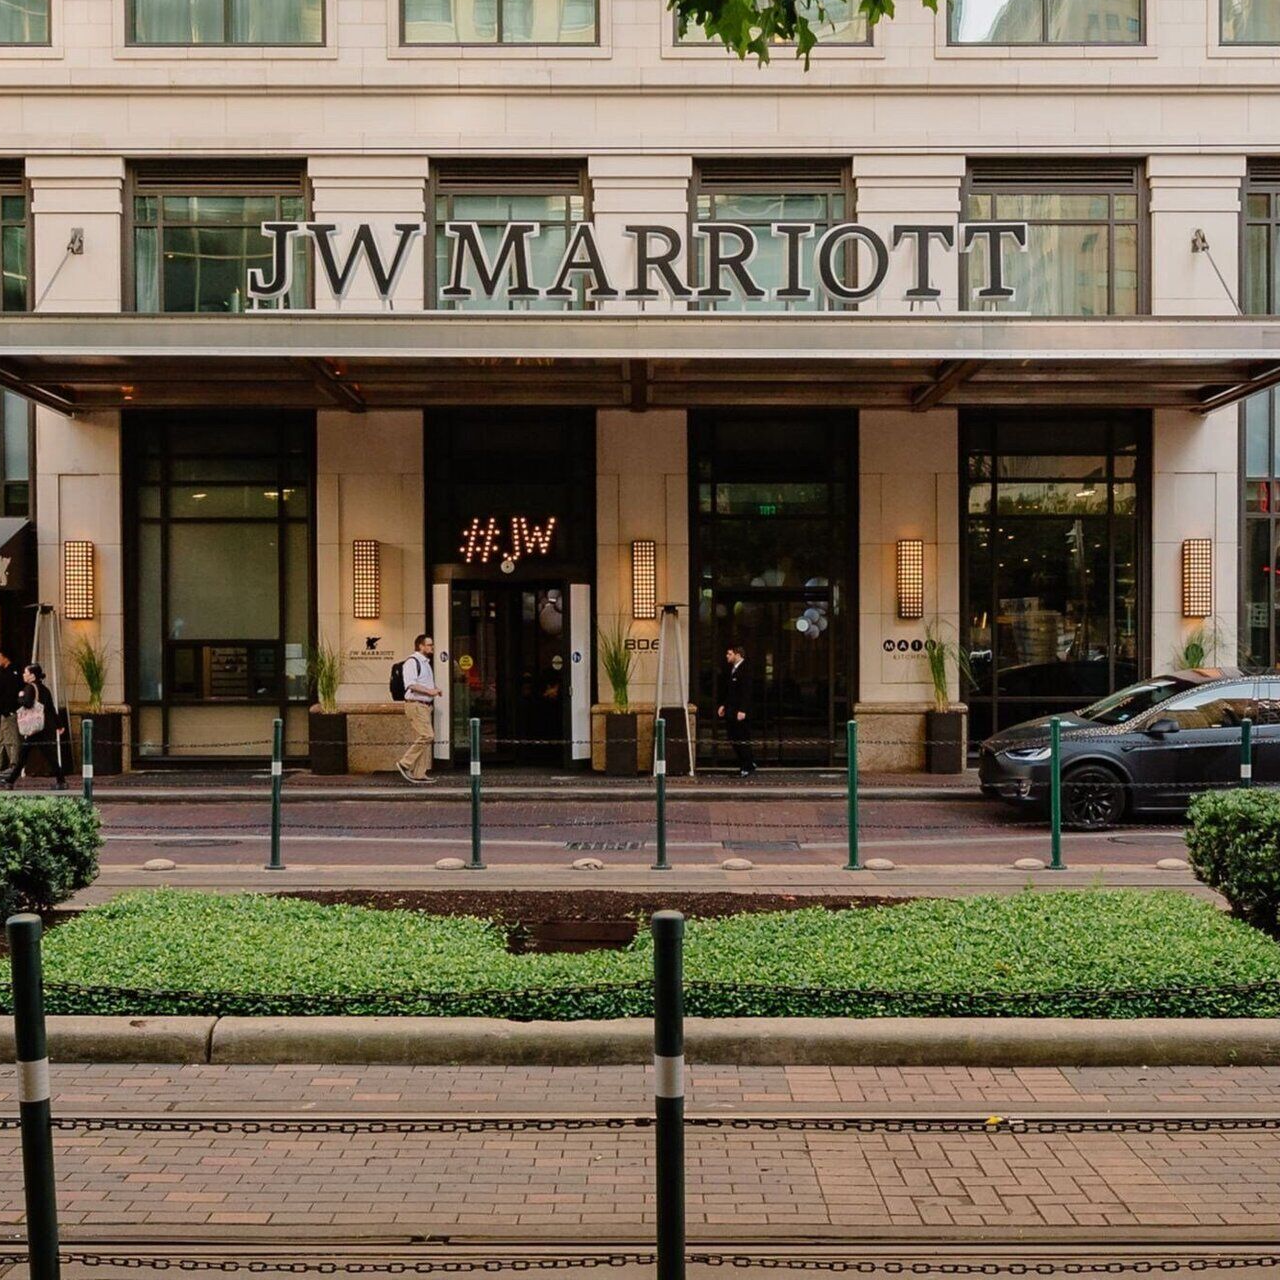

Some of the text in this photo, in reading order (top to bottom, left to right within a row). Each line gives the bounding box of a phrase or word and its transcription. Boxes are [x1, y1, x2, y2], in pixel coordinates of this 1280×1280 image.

[248, 222, 1028, 300] JW MARRIOTT
[459, 517, 556, 563] #JW
